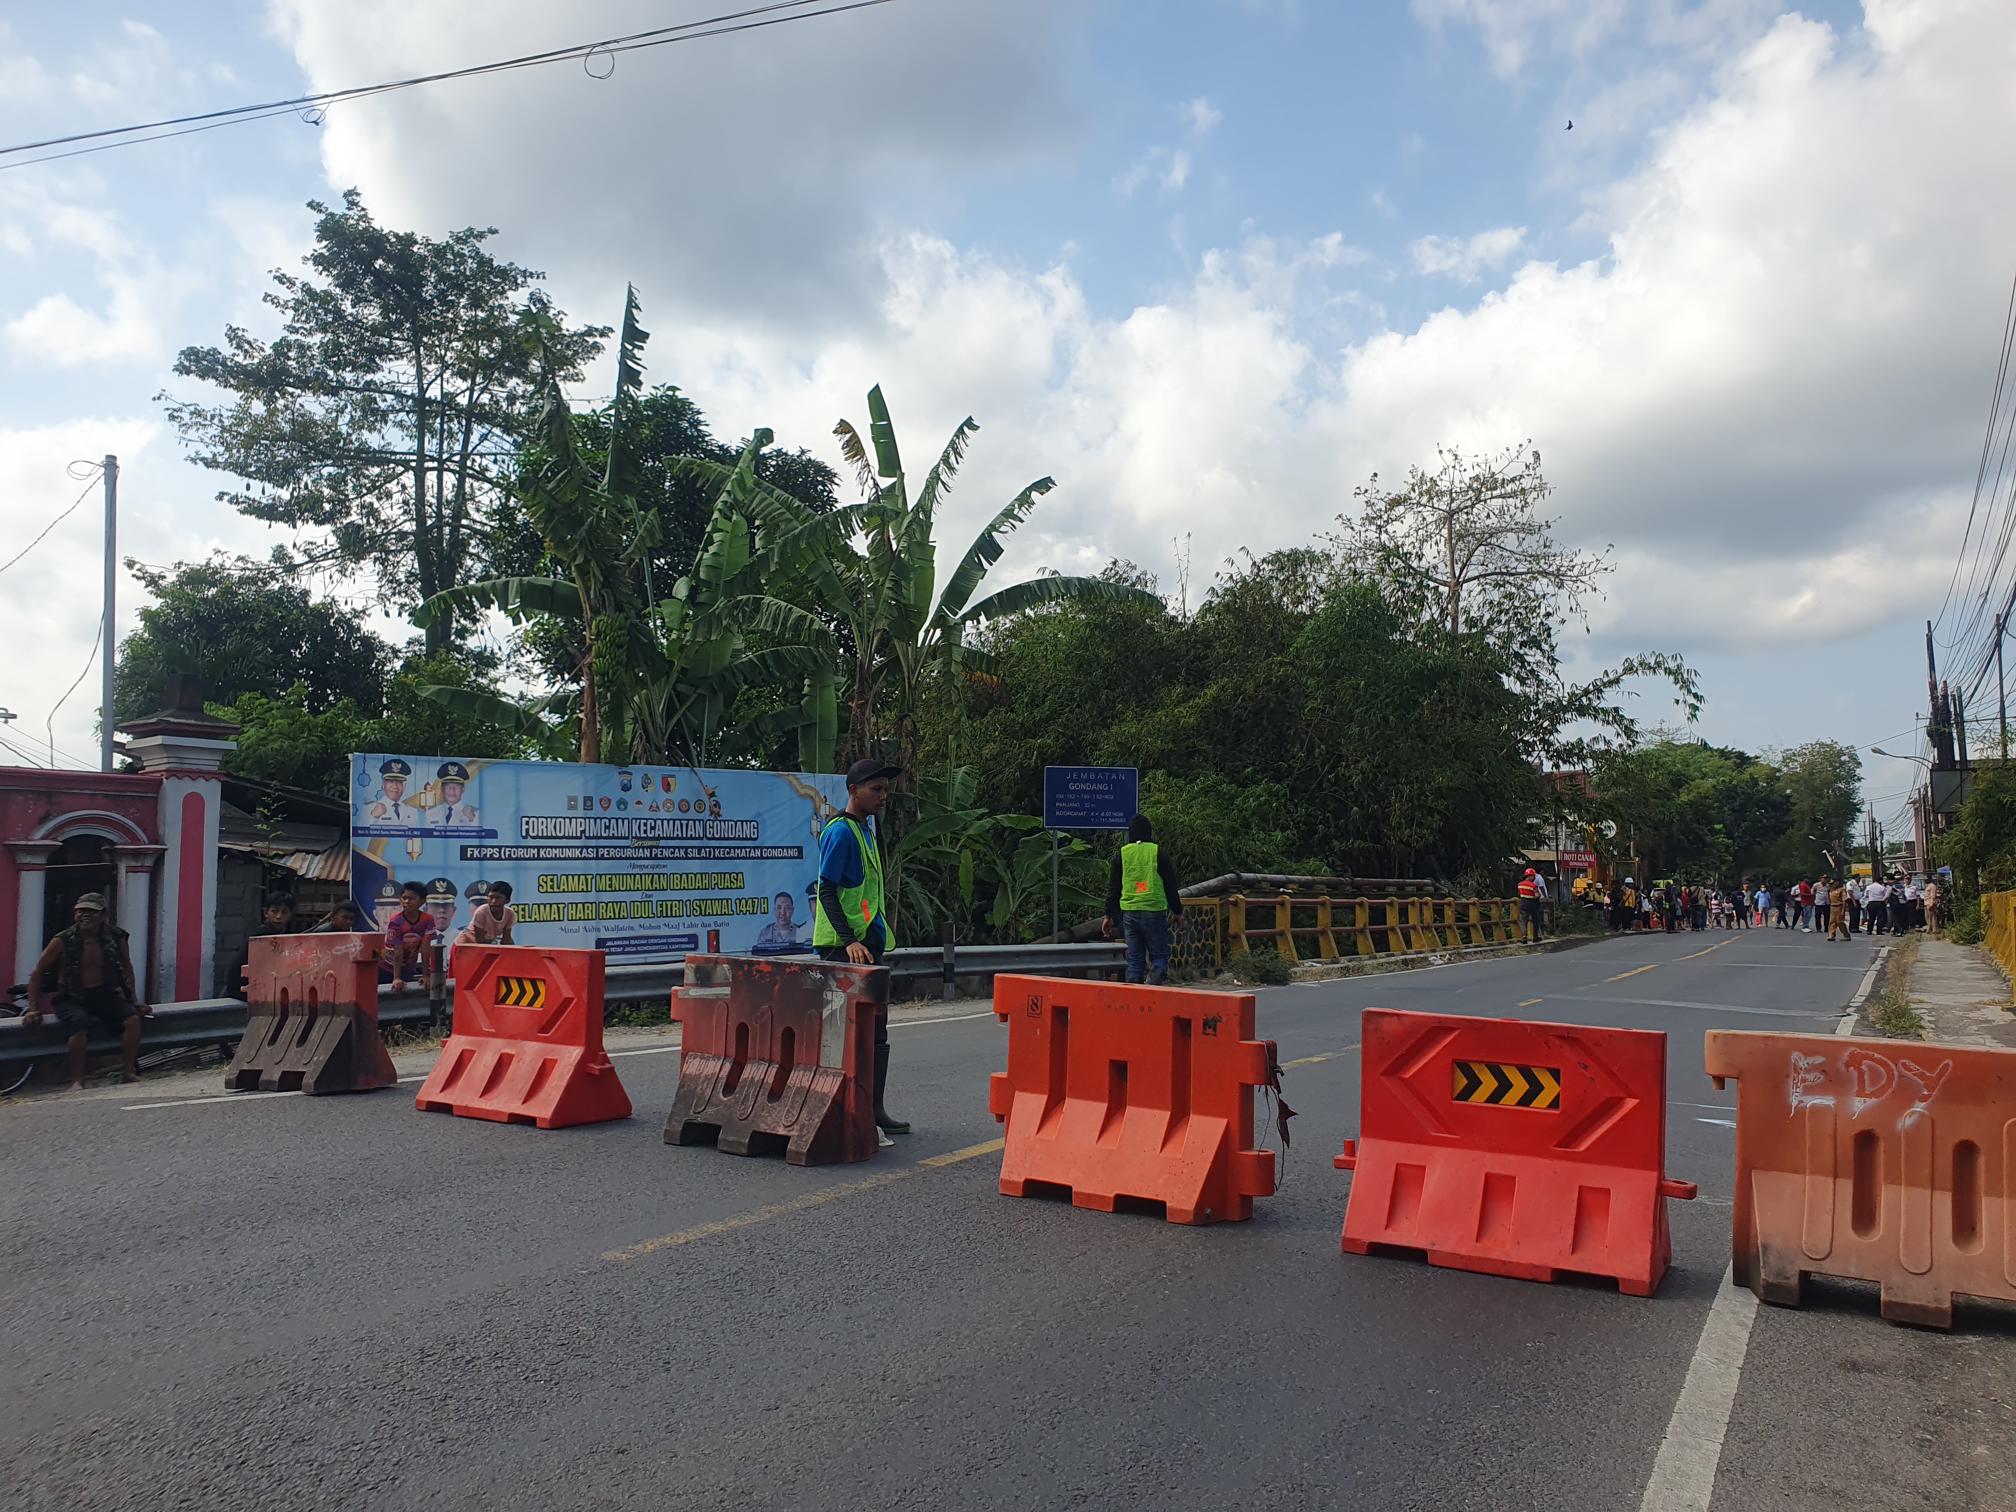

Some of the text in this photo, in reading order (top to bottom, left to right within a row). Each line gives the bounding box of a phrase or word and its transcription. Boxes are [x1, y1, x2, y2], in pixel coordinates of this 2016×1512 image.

[1066, 771, 1125, 780] JEMBATAN
[521, 817, 758, 839] FORKOMPIMCAM KECAMATAN GONDANG
[467, 847, 799, 859] FKPPS (FORUM KOMUNIKASI PERGURUAN PENCAK SILAT) KECAMATAN GONDANG
[539, 872, 745, 892] SELAMAT MENUNAIKAN IBADAH PUASA
[511, 897, 768, 922] SELAMAT HARI RAYA IDUL FITRI 1 SYAWAL 1447 H
[1789, 1046, 1953, 1133] EDY
